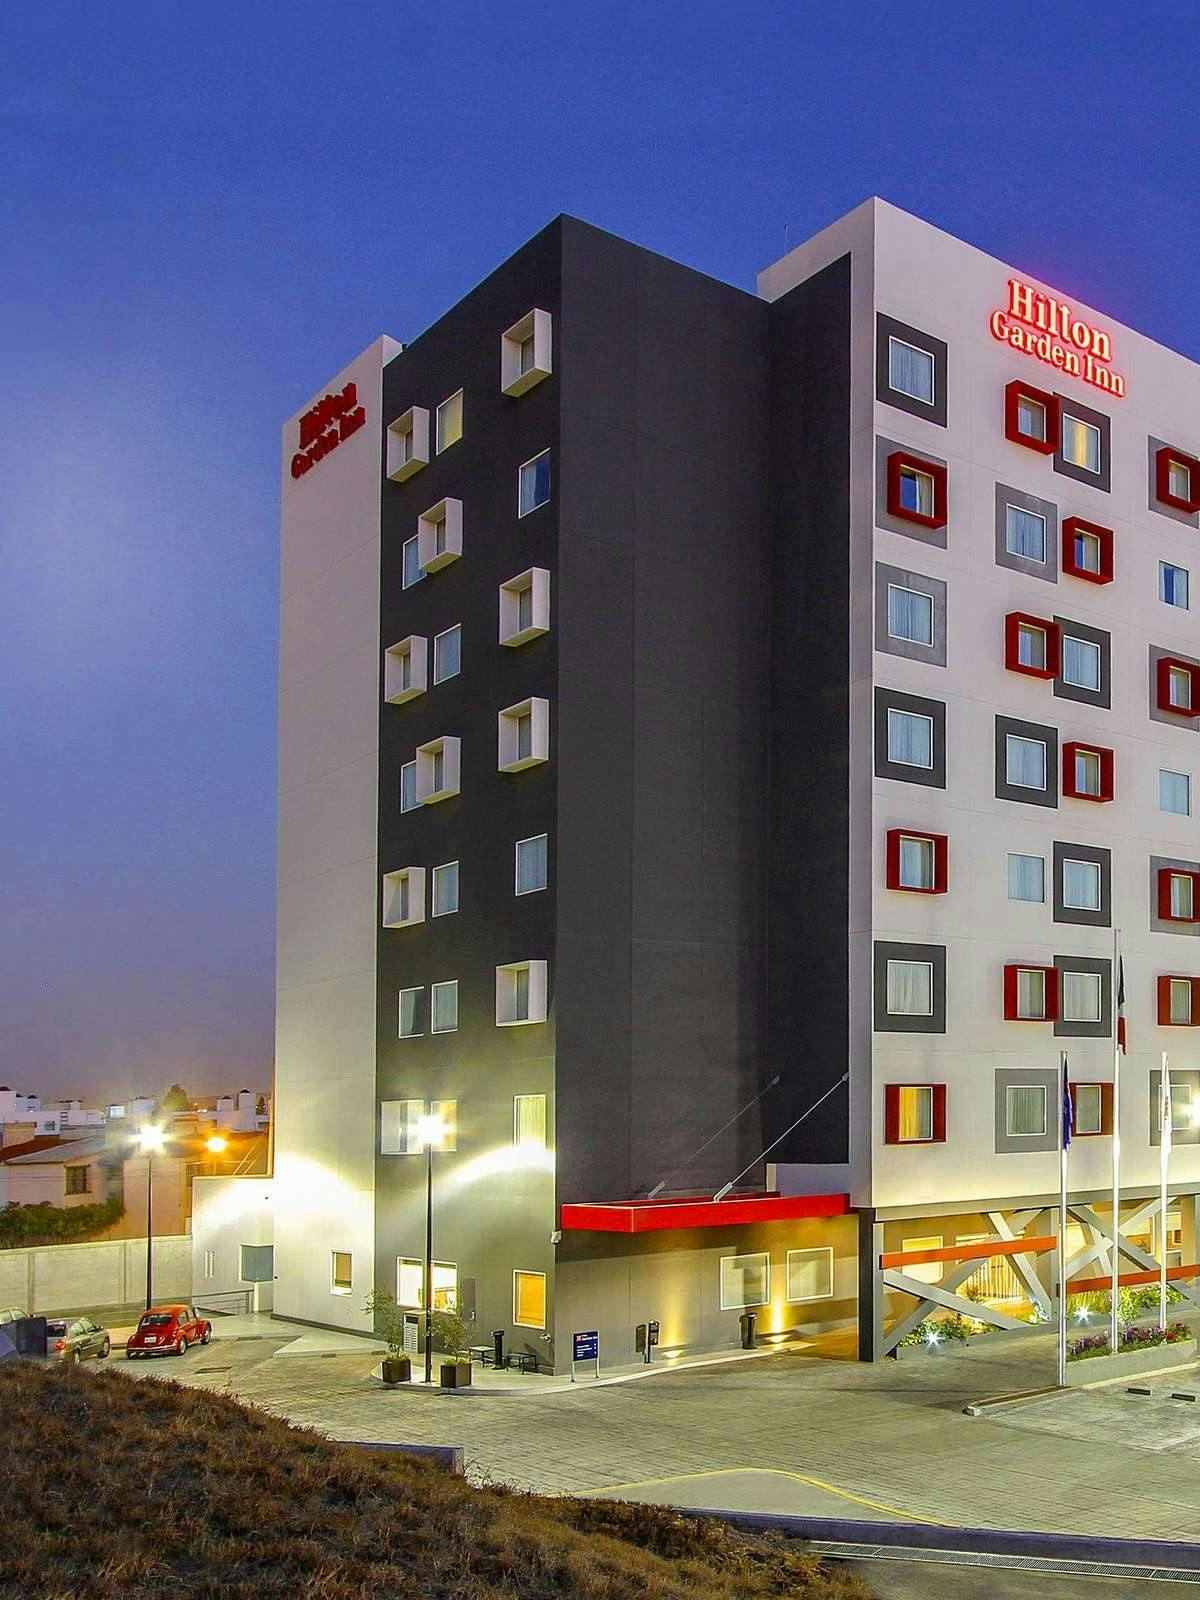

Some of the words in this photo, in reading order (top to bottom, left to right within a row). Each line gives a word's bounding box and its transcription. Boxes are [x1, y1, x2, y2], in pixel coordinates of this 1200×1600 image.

[990, 311, 1080, 377] Garden
[1083, 355, 1127, 397] Inn
[1009, 280, 1112, 362] Hilton
